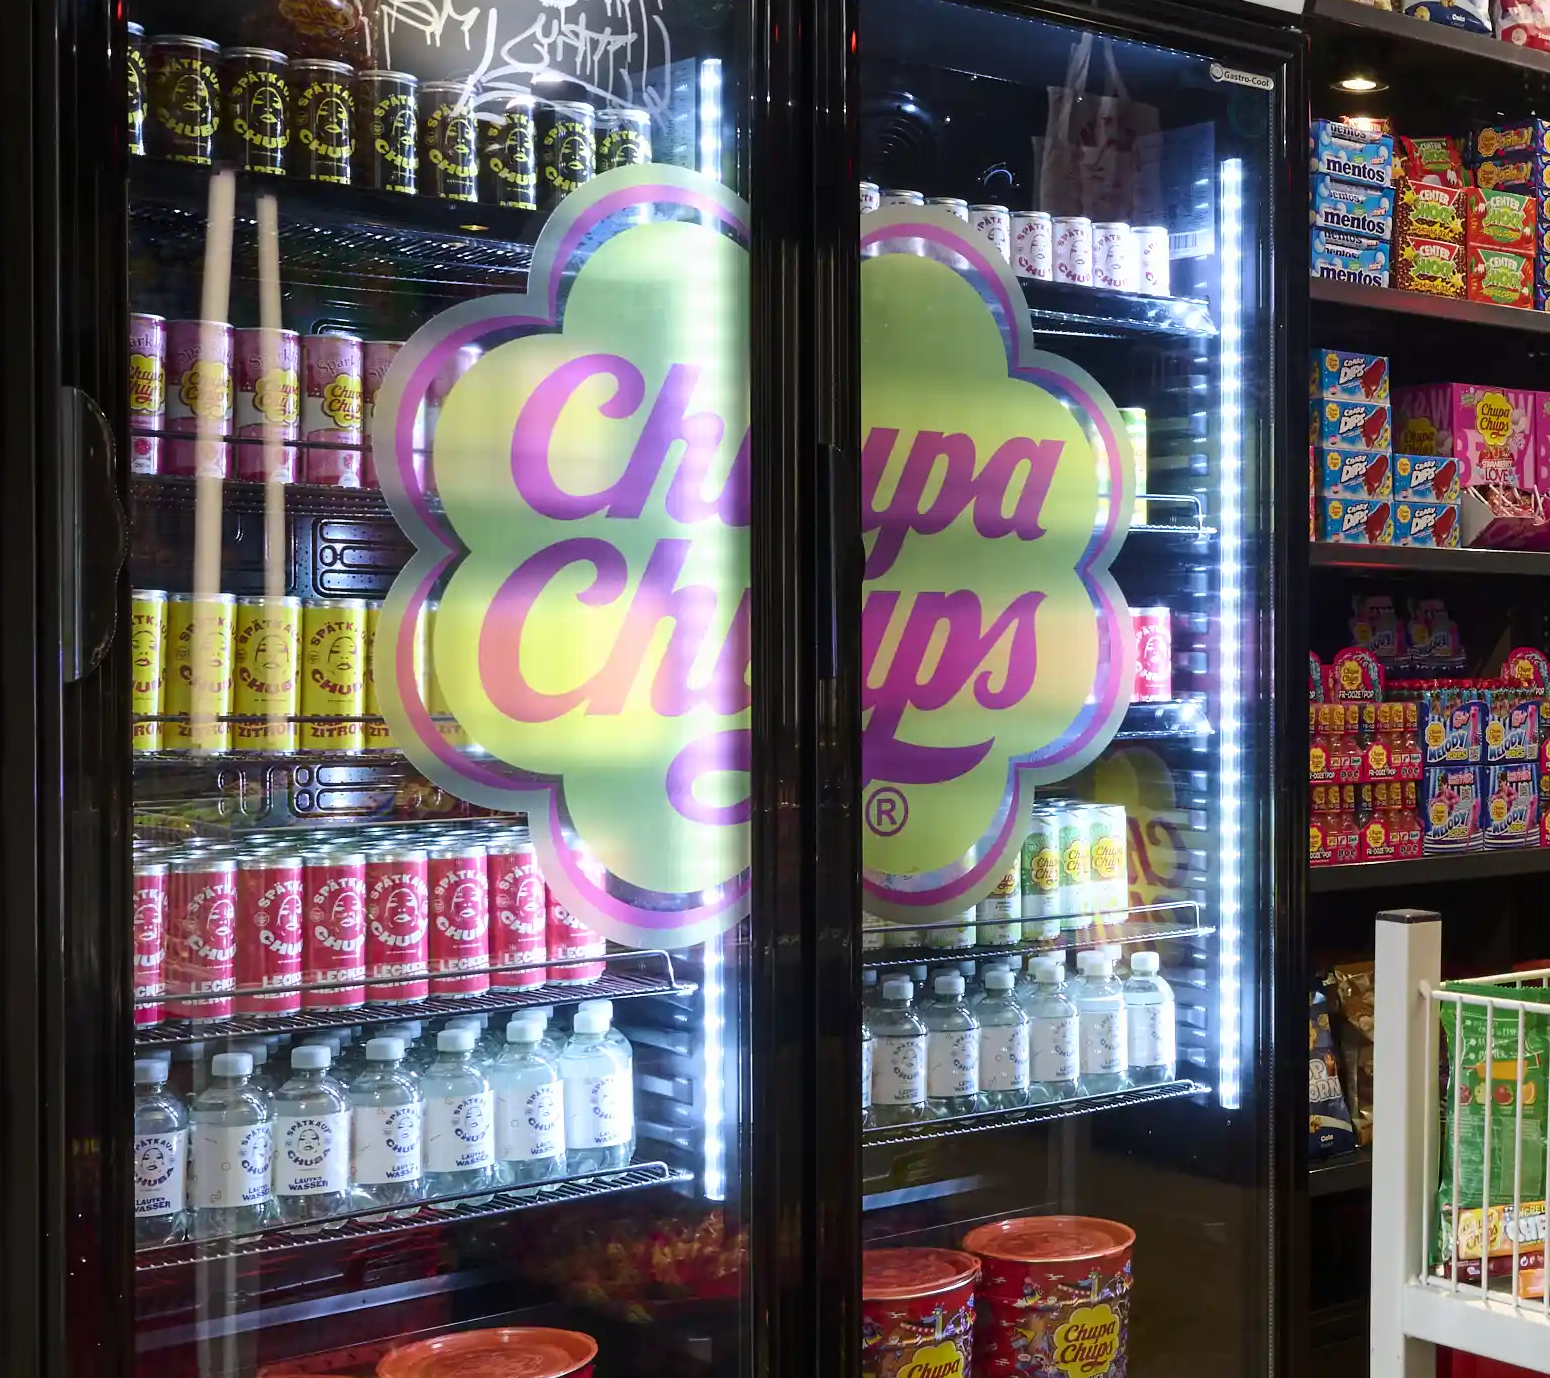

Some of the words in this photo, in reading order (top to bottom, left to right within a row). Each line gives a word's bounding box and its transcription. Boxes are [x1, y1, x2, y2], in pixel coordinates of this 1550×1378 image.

[1224, 71, 1269, 87] Gastro-Cool
[1326, 158, 1385, 183] mentos
[1419, 190, 1449, 204] CENTER
[1324, 211, 1385, 234] mentos
[1419, 246, 1450, 259] CENTER
[1320, 266, 1382, 286] mentos
[1481, 405, 1510, 419] Chupa
[1480, 417, 1510, 437] Chups
[1063, 1320, 1116, 1344] Chupa
[1060, 1338, 1114, 1372] Chups
